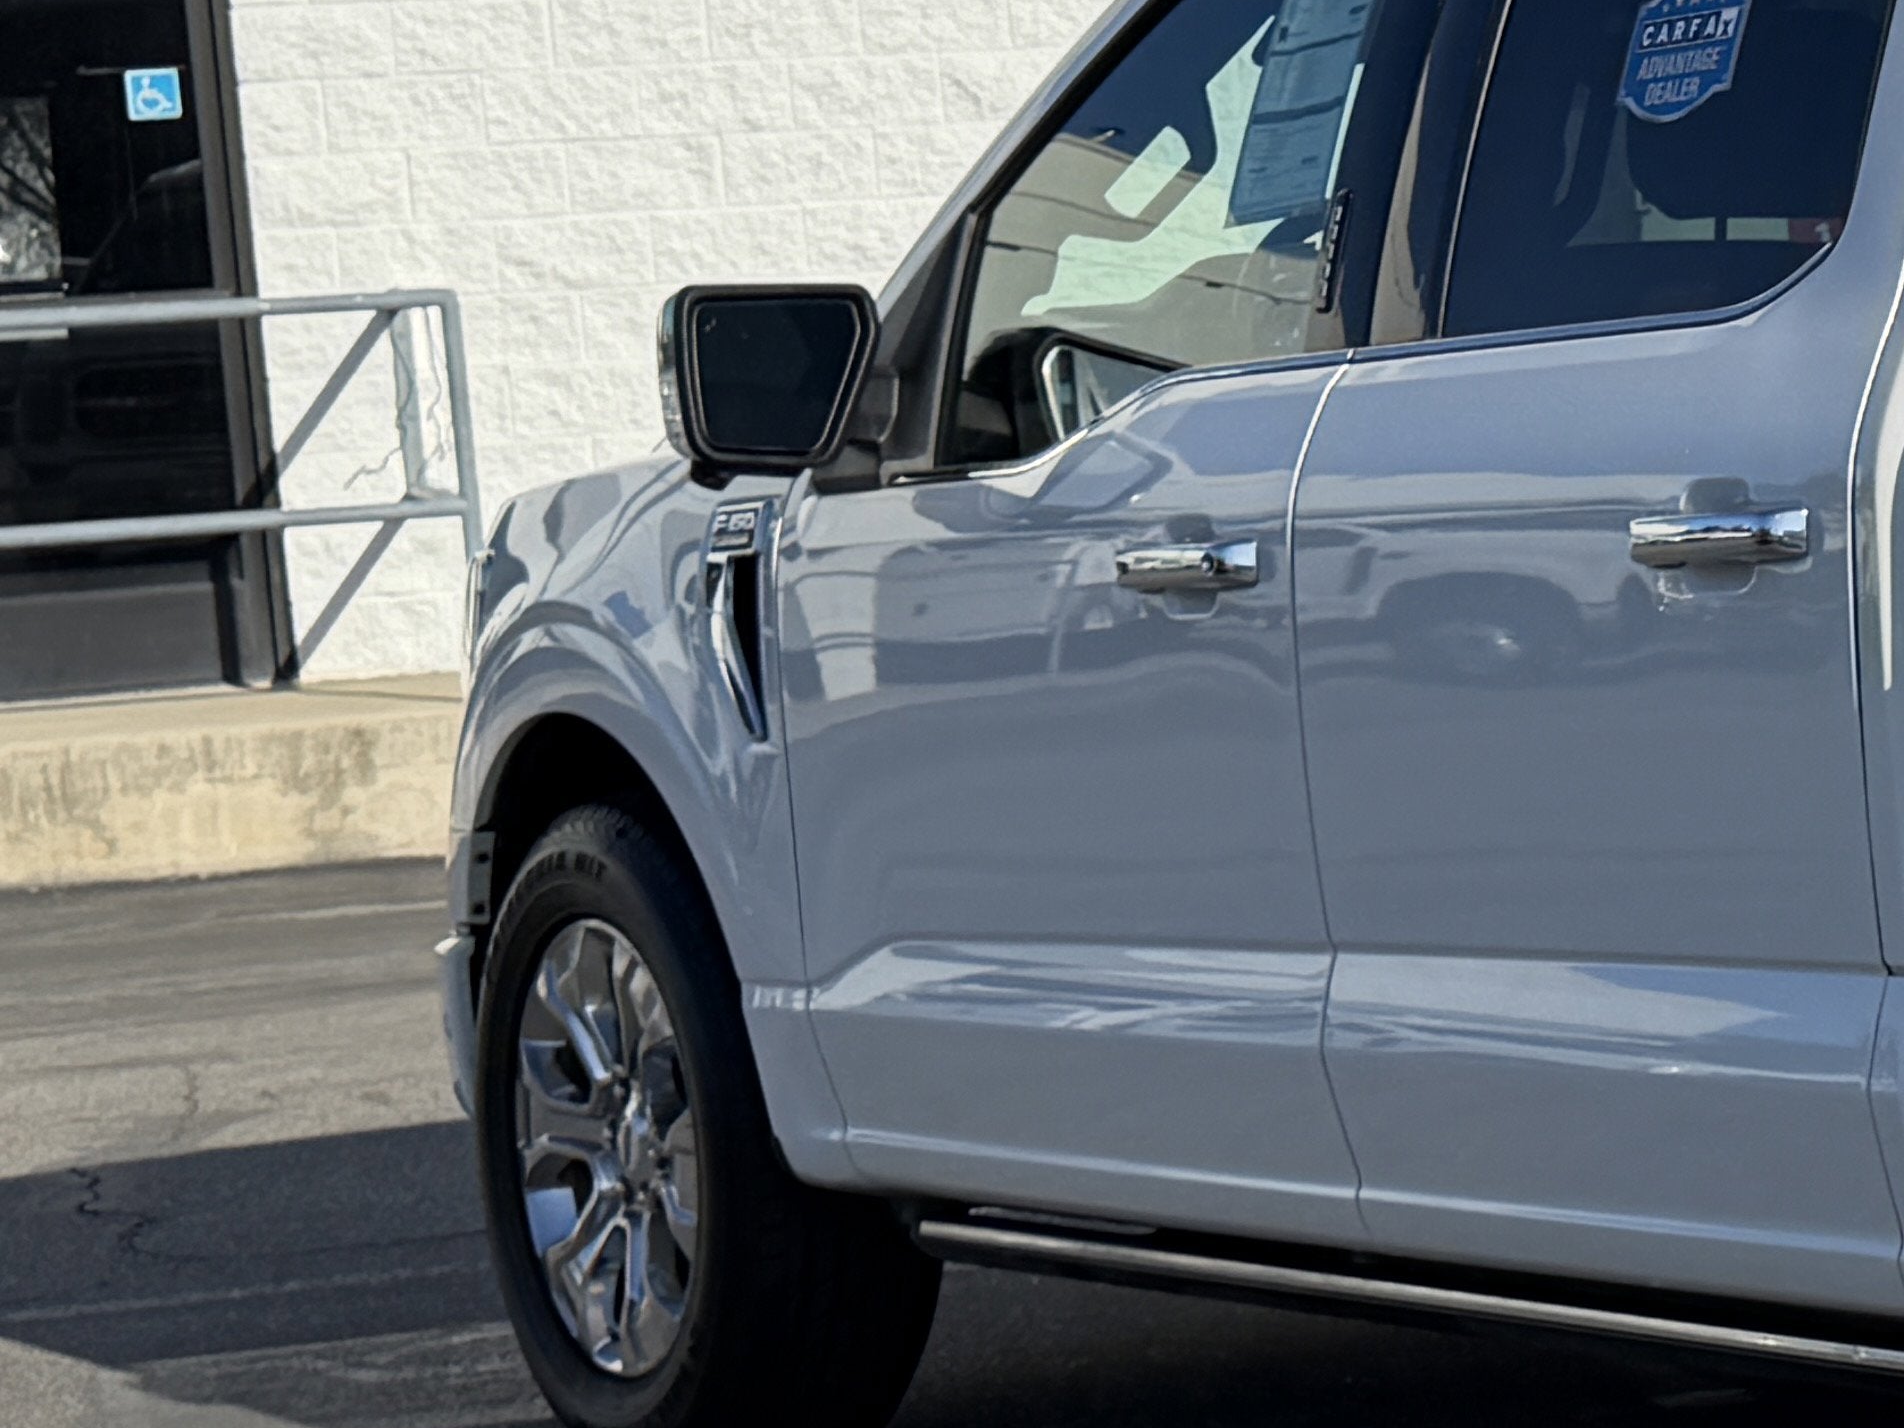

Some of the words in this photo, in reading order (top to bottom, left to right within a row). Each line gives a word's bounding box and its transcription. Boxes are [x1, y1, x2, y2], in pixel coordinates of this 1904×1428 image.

[1642, 10, 1738, 46] CARFAX
[1638, 47, 1722, 79] ADVANTAGE
[1645, 77, 1700, 105] DEALER
